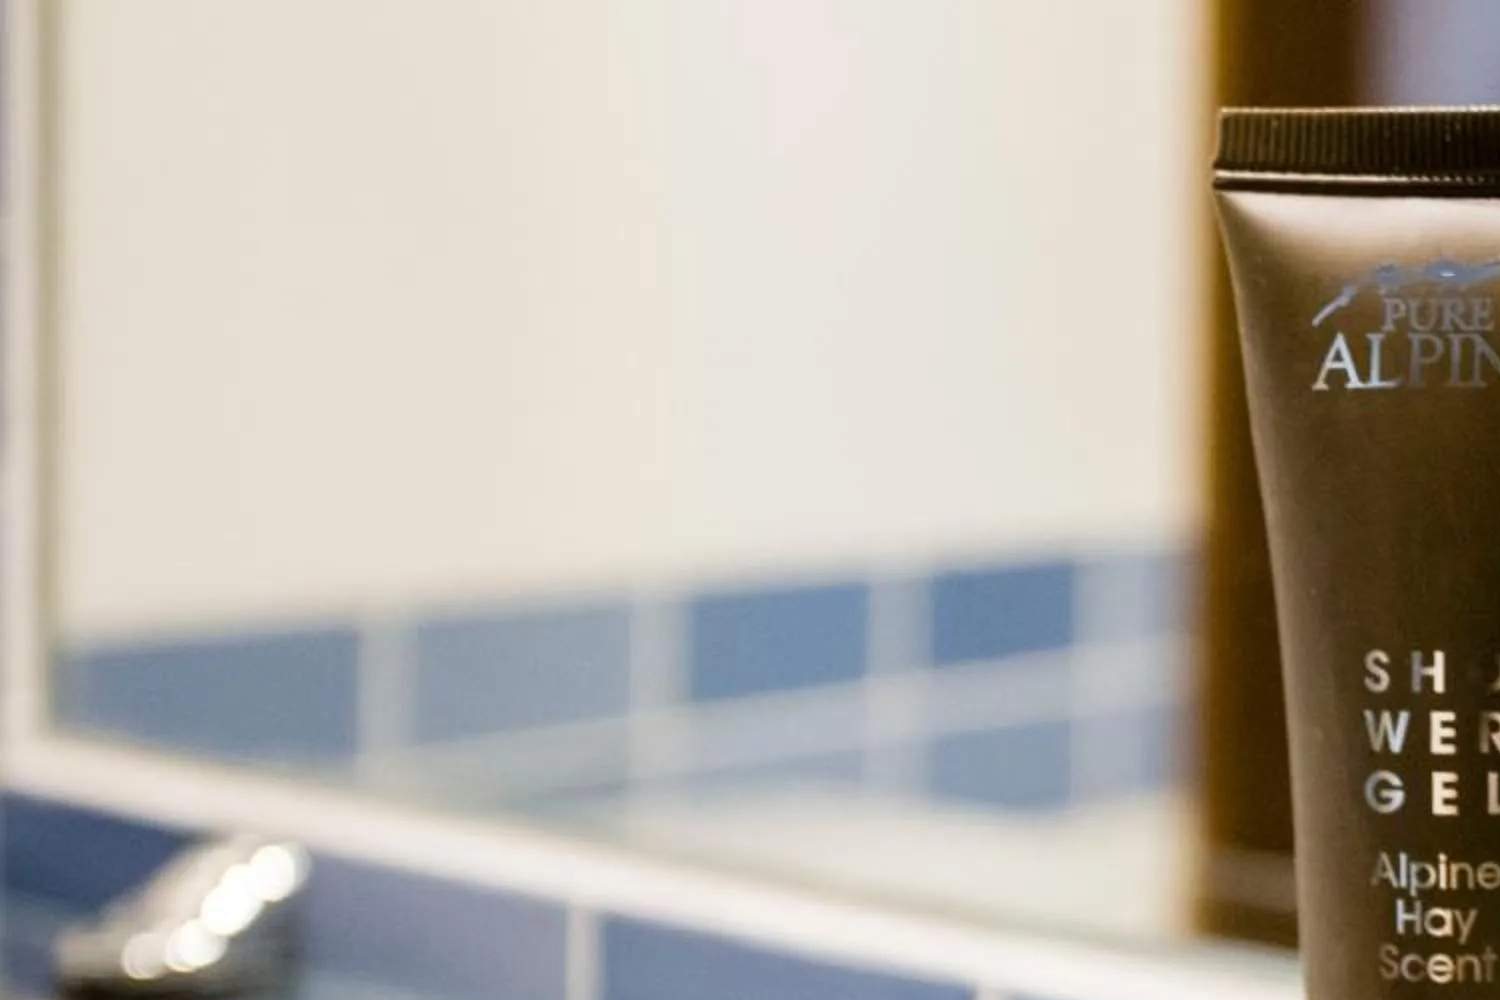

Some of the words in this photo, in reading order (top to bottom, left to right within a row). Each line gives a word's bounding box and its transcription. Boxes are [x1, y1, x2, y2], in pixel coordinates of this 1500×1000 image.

[1382, 298, 1496, 332] PURE
[1396, 899, 1479, 945] Hay
[1379, 944, 1499, 985] Scent
